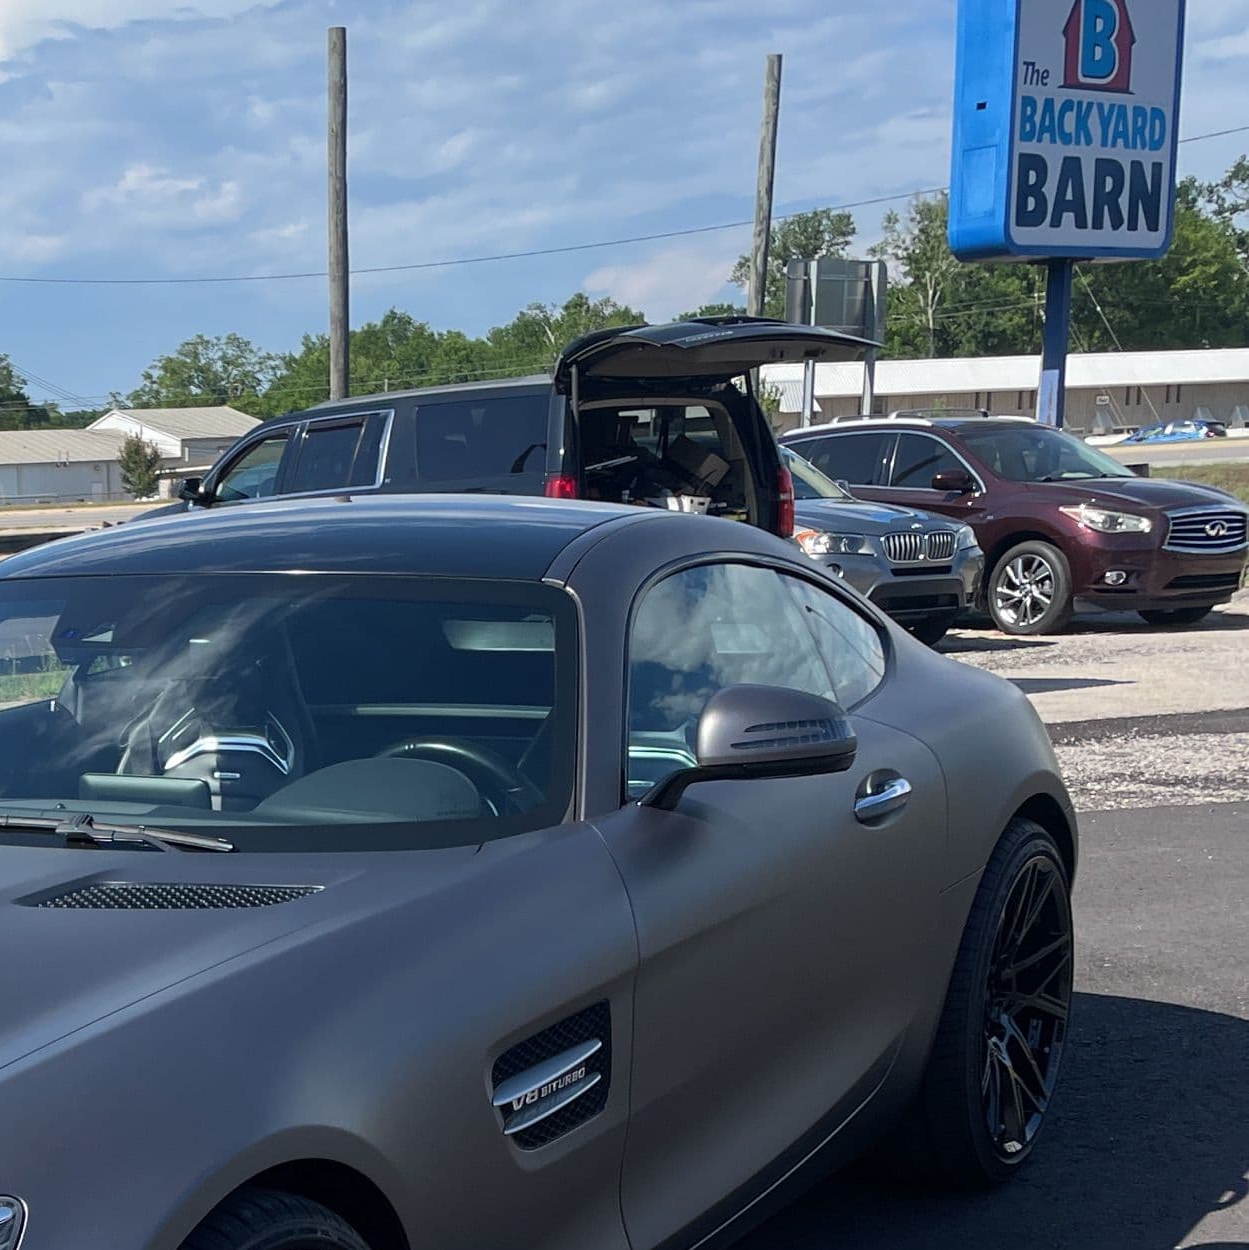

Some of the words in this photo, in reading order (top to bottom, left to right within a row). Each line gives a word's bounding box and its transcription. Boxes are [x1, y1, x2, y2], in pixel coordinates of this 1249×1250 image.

[1022, 61, 1050, 87] The
[1019, 96, 1167, 151] BACKYARD
[1015, 152, 1164, 232] BARN
[511, 1089, 540, 1111] V8
[540, 1067, 586, 1098] BITURBO
